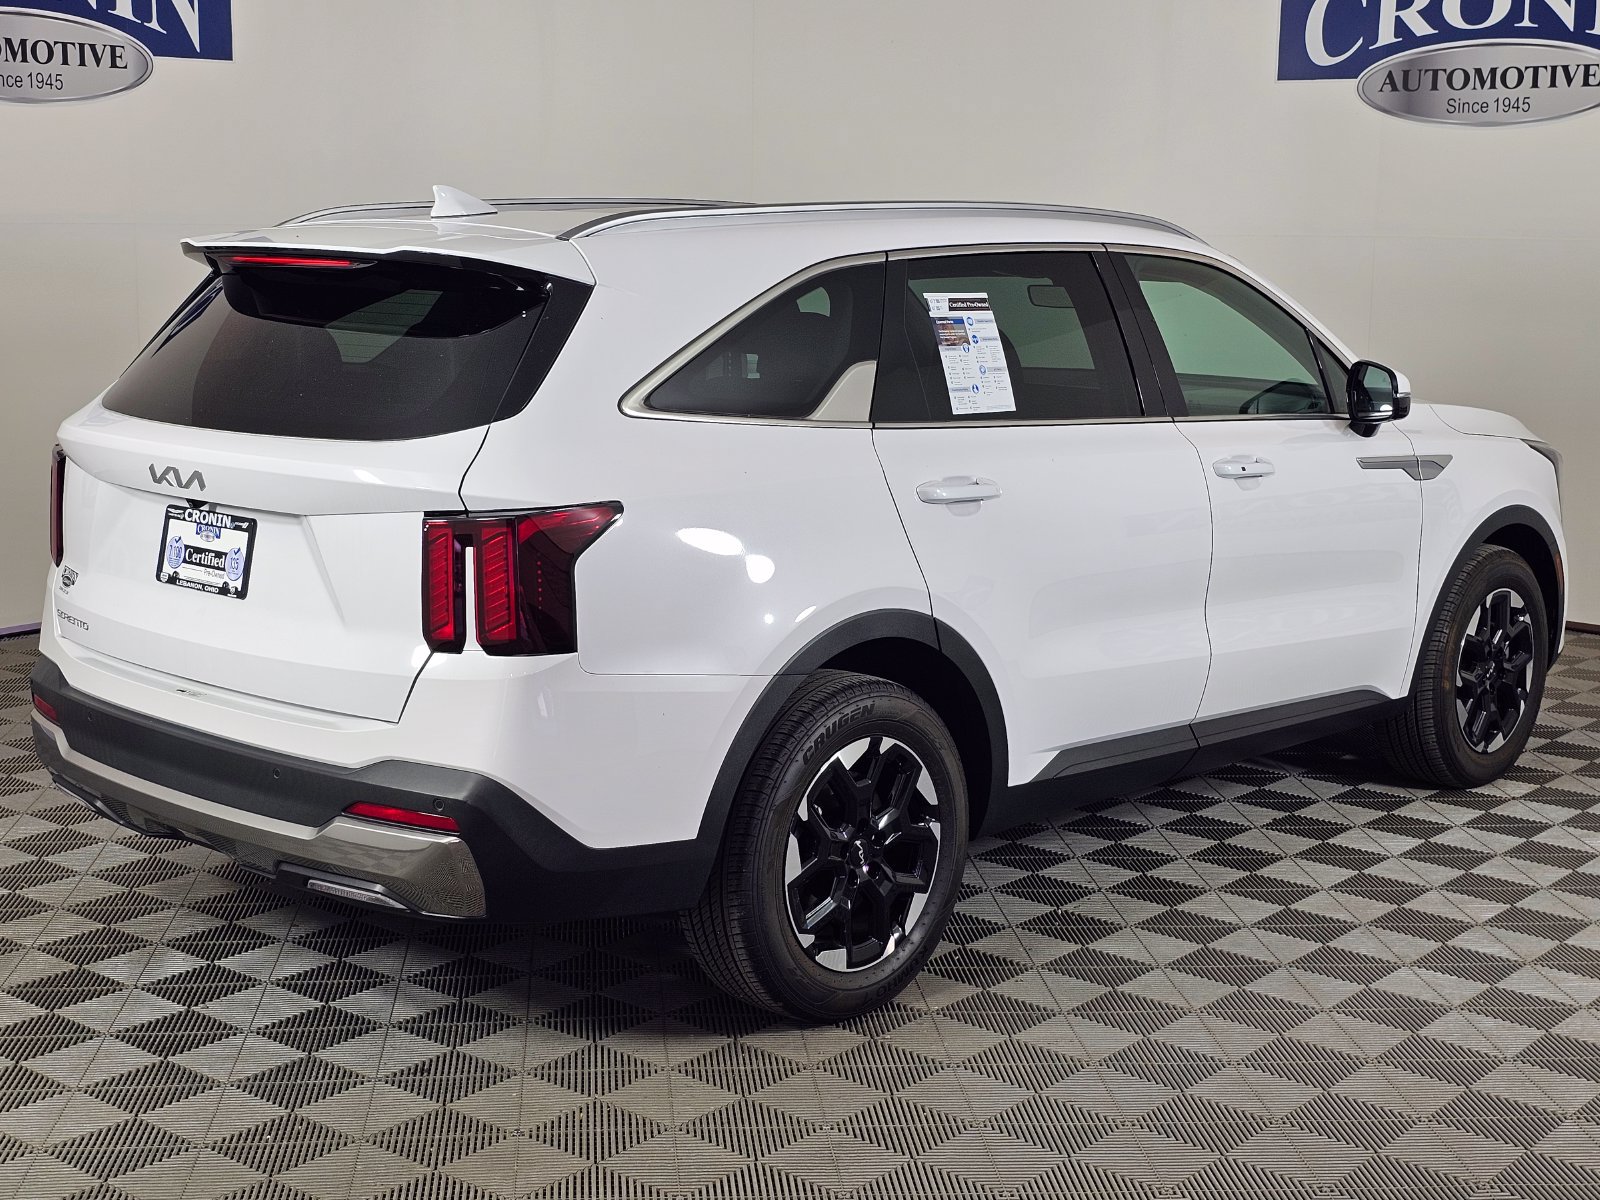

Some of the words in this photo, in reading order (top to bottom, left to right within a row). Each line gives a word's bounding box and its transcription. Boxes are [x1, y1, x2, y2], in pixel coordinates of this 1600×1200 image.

[0, 37, 128, 69] MOTIVE
[27, 72, 64, 90] 1945
[1378, 64, 1600, 92] AUTOMOTIVE
[1446, 98, 1489, 114] Since
[1493, 97, 1531, 113] 1945
[148, 463, 206, 491] KIA
[184, 508, 232, 528] CRONIN
[197, 523, 221, 537] CRONIN
[185, 548, 225, 568] Certified
[203, 568, 225, 579] Pre-Owned
[204, 585, 219, 594] OHIO
[803, 703, 875, 766] CRUGEN
